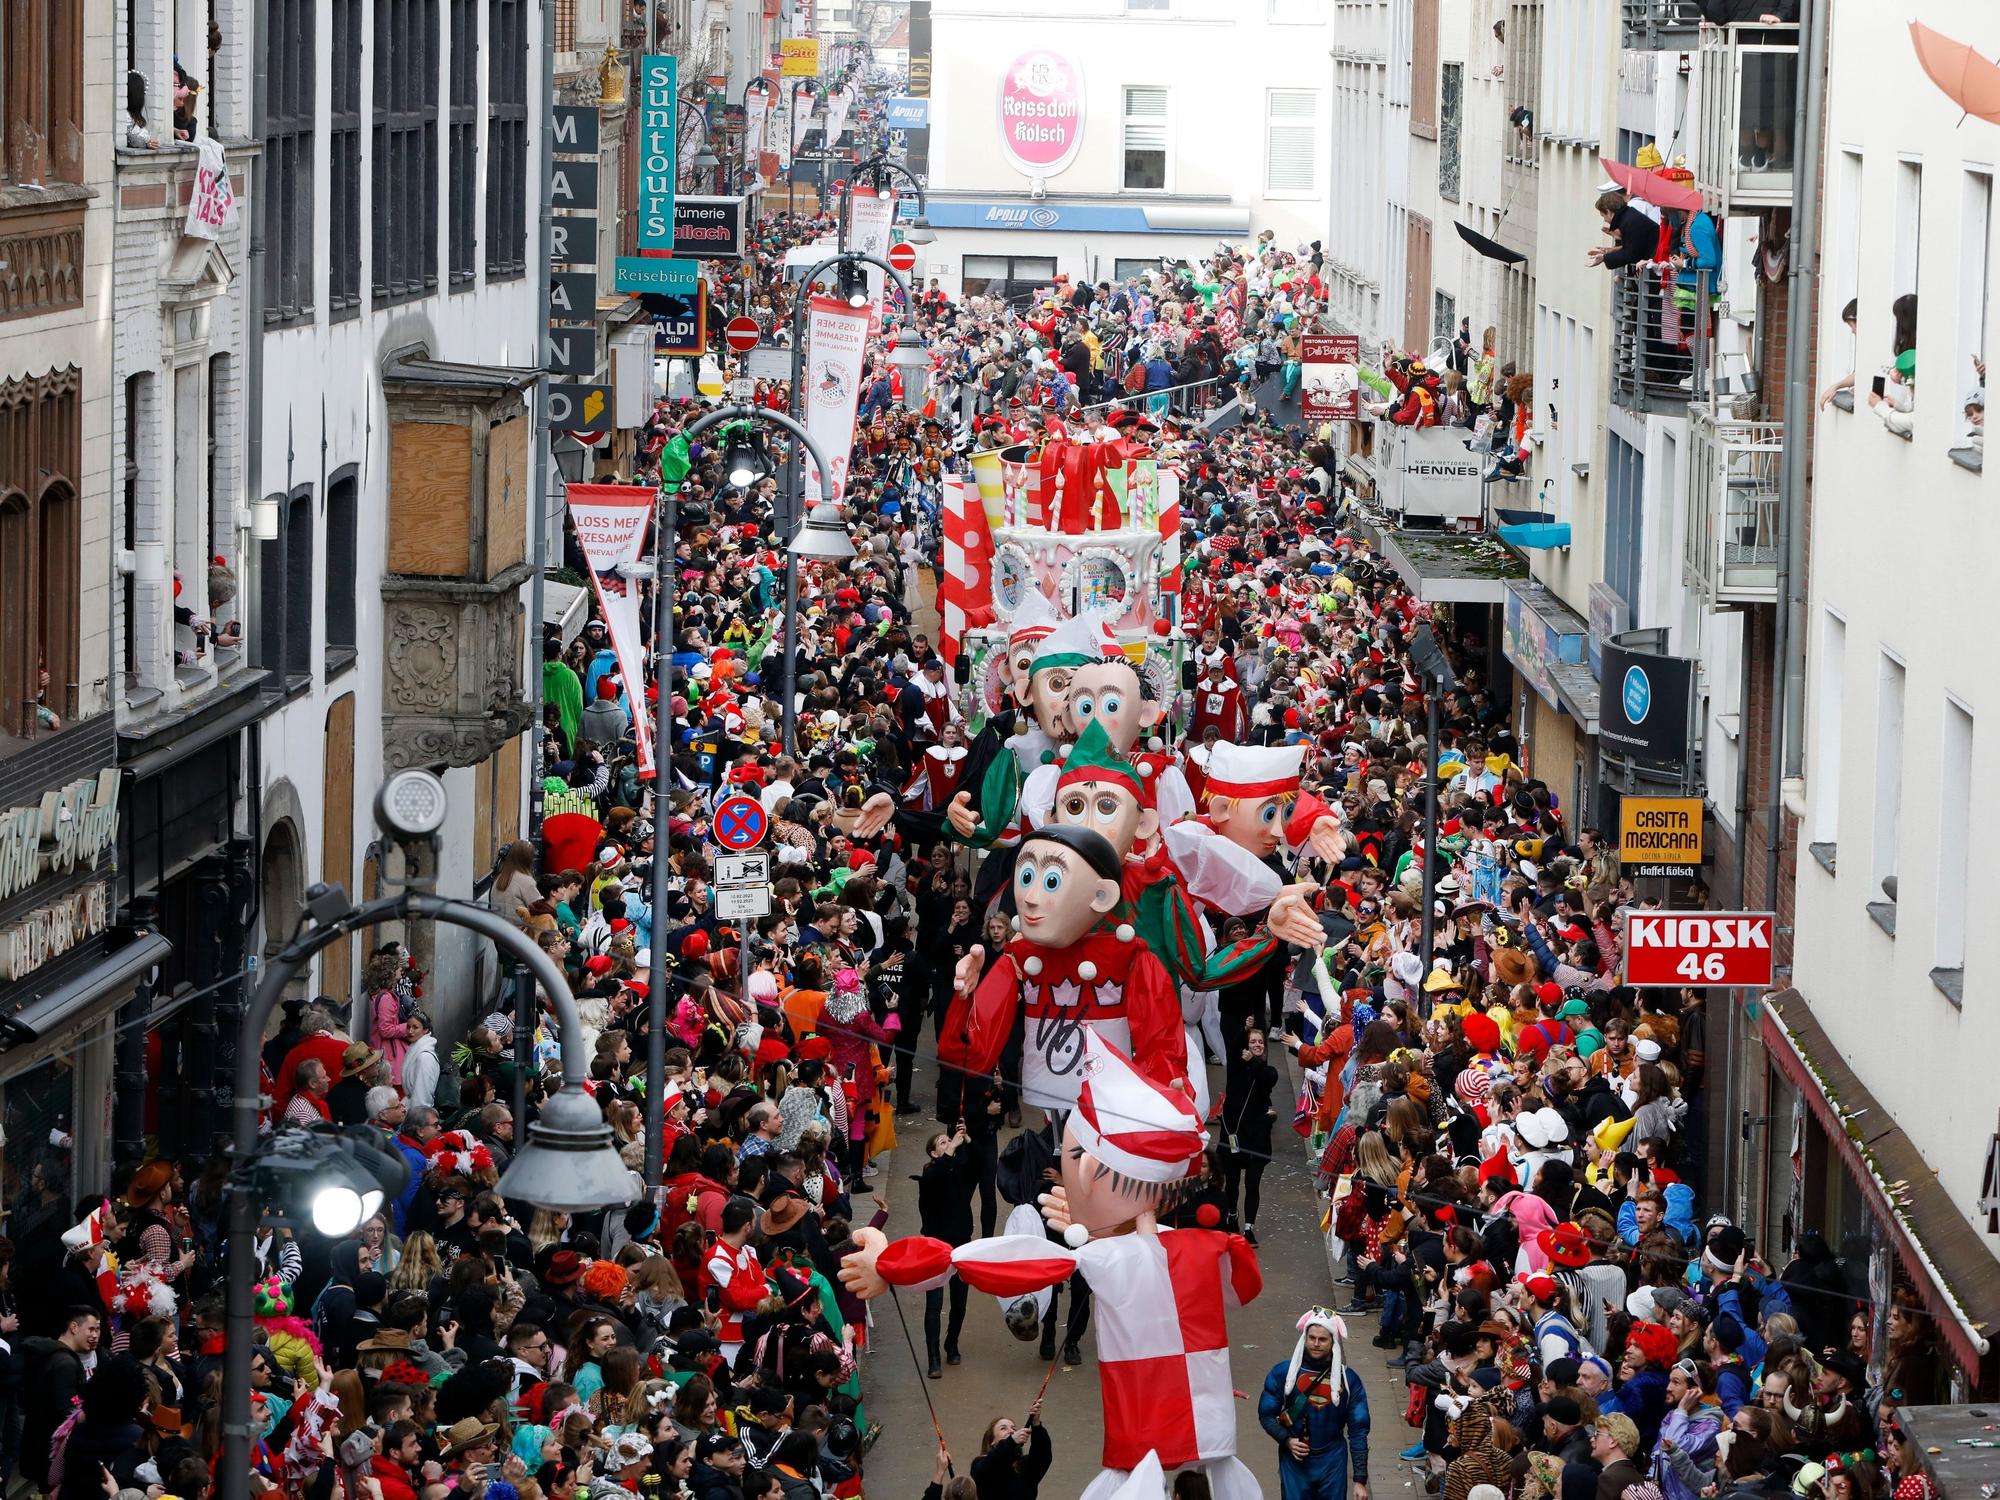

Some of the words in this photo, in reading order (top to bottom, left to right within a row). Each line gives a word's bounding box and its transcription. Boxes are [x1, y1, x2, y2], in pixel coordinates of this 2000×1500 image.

[784, 45, 817, 58] Netto
[892, 106, 924, 118] APOLLO
[1014, 121, 1066, 145] Kölsch
[646, 66, 671, 238] suntours
[986, 206, 1029, 222] APOLLO
[617, 268, 696, 284] Reisebüro
[655, 321, 695, 336] ALDI
[665, 336, 682, 344] SÜD
[1408, 465, 1479, 476] HENNES
[577, 516, 610, 529] LOSS
[614, 518, 641, 529] MER
[1636, 811, 1689, 829] CASITA
[1625, 832, 1698, 850] MEXICANA
[1641, 866, 1666, 877] Gaffel
[1666, 866, 1695, 878] Kölsch
[1631, 919, 1770, 949] KIOSK
[1676, 952, 1726, 981] 46
[877, 974, 903, 983] SWAT
